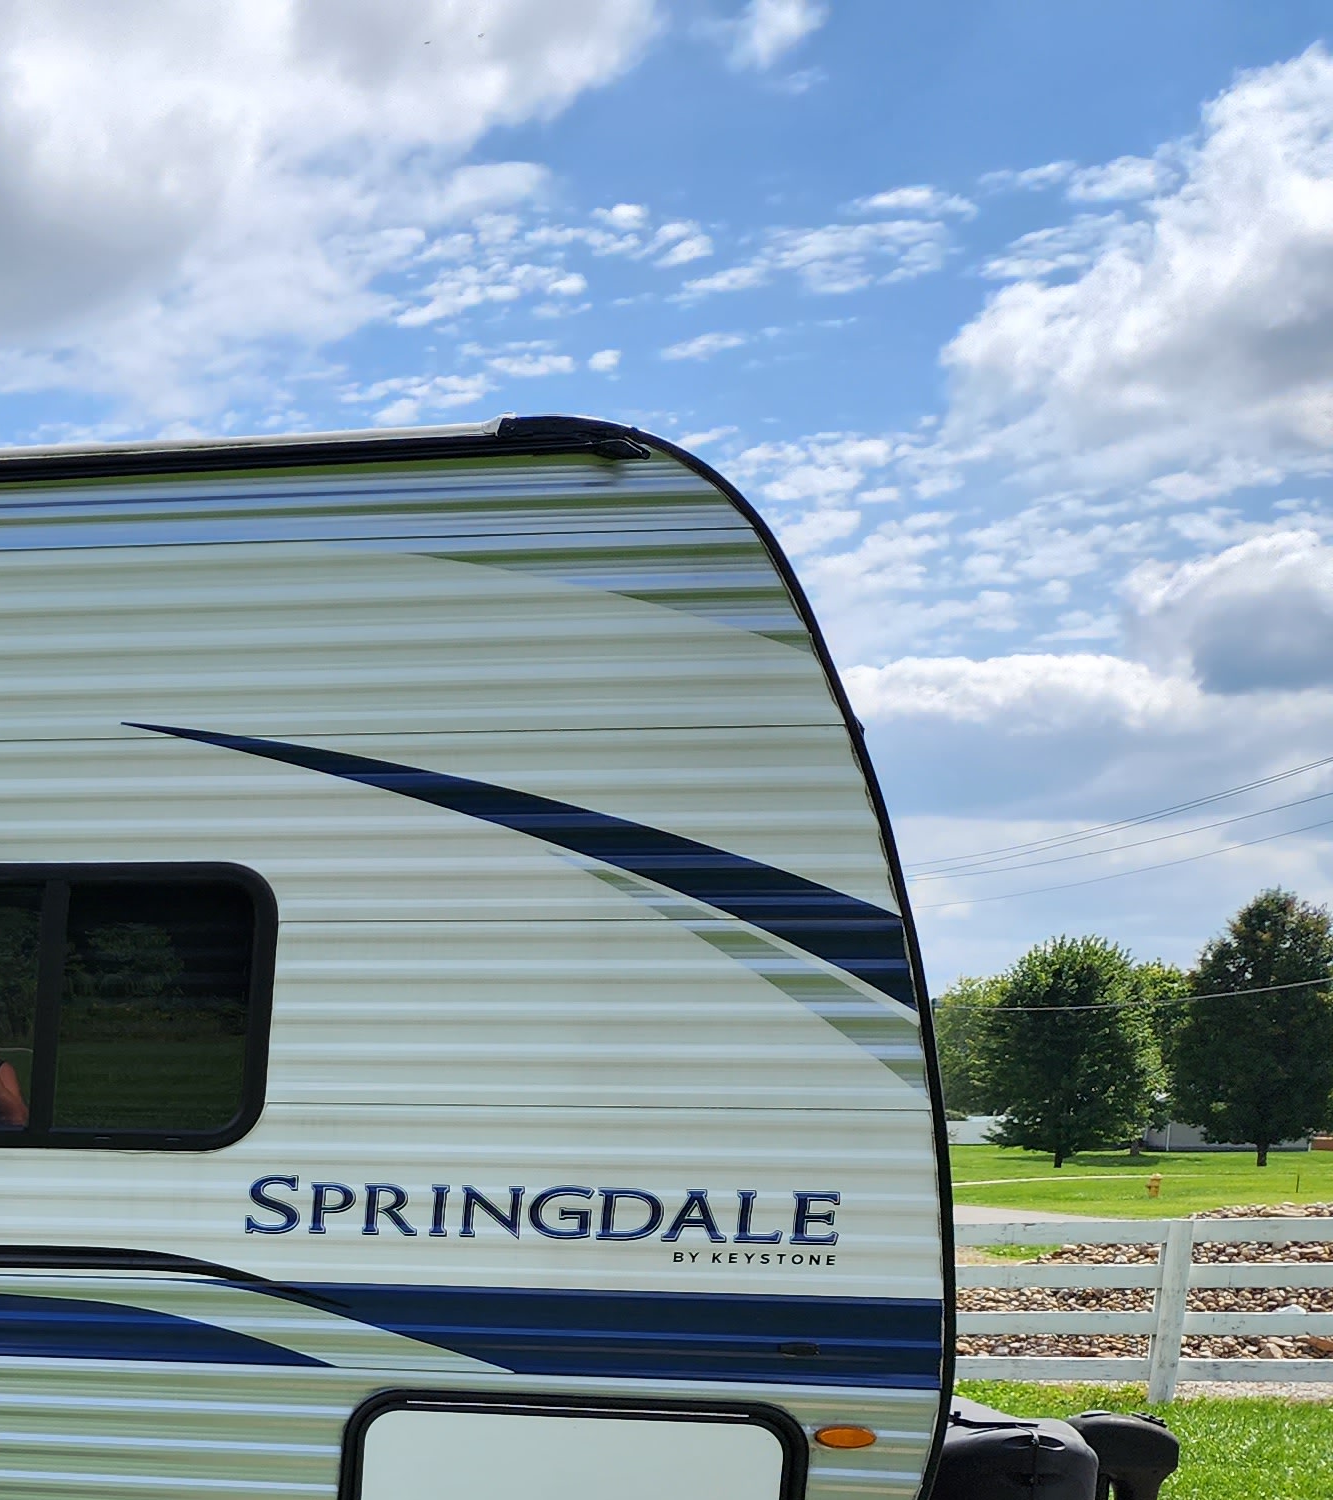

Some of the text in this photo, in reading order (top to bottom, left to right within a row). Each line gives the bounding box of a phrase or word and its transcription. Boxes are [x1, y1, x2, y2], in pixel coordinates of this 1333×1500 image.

[245, 1174, 840, 1246] SPRINGDALE
[673, 1251, 836, 1266] BY KEYSTONE
